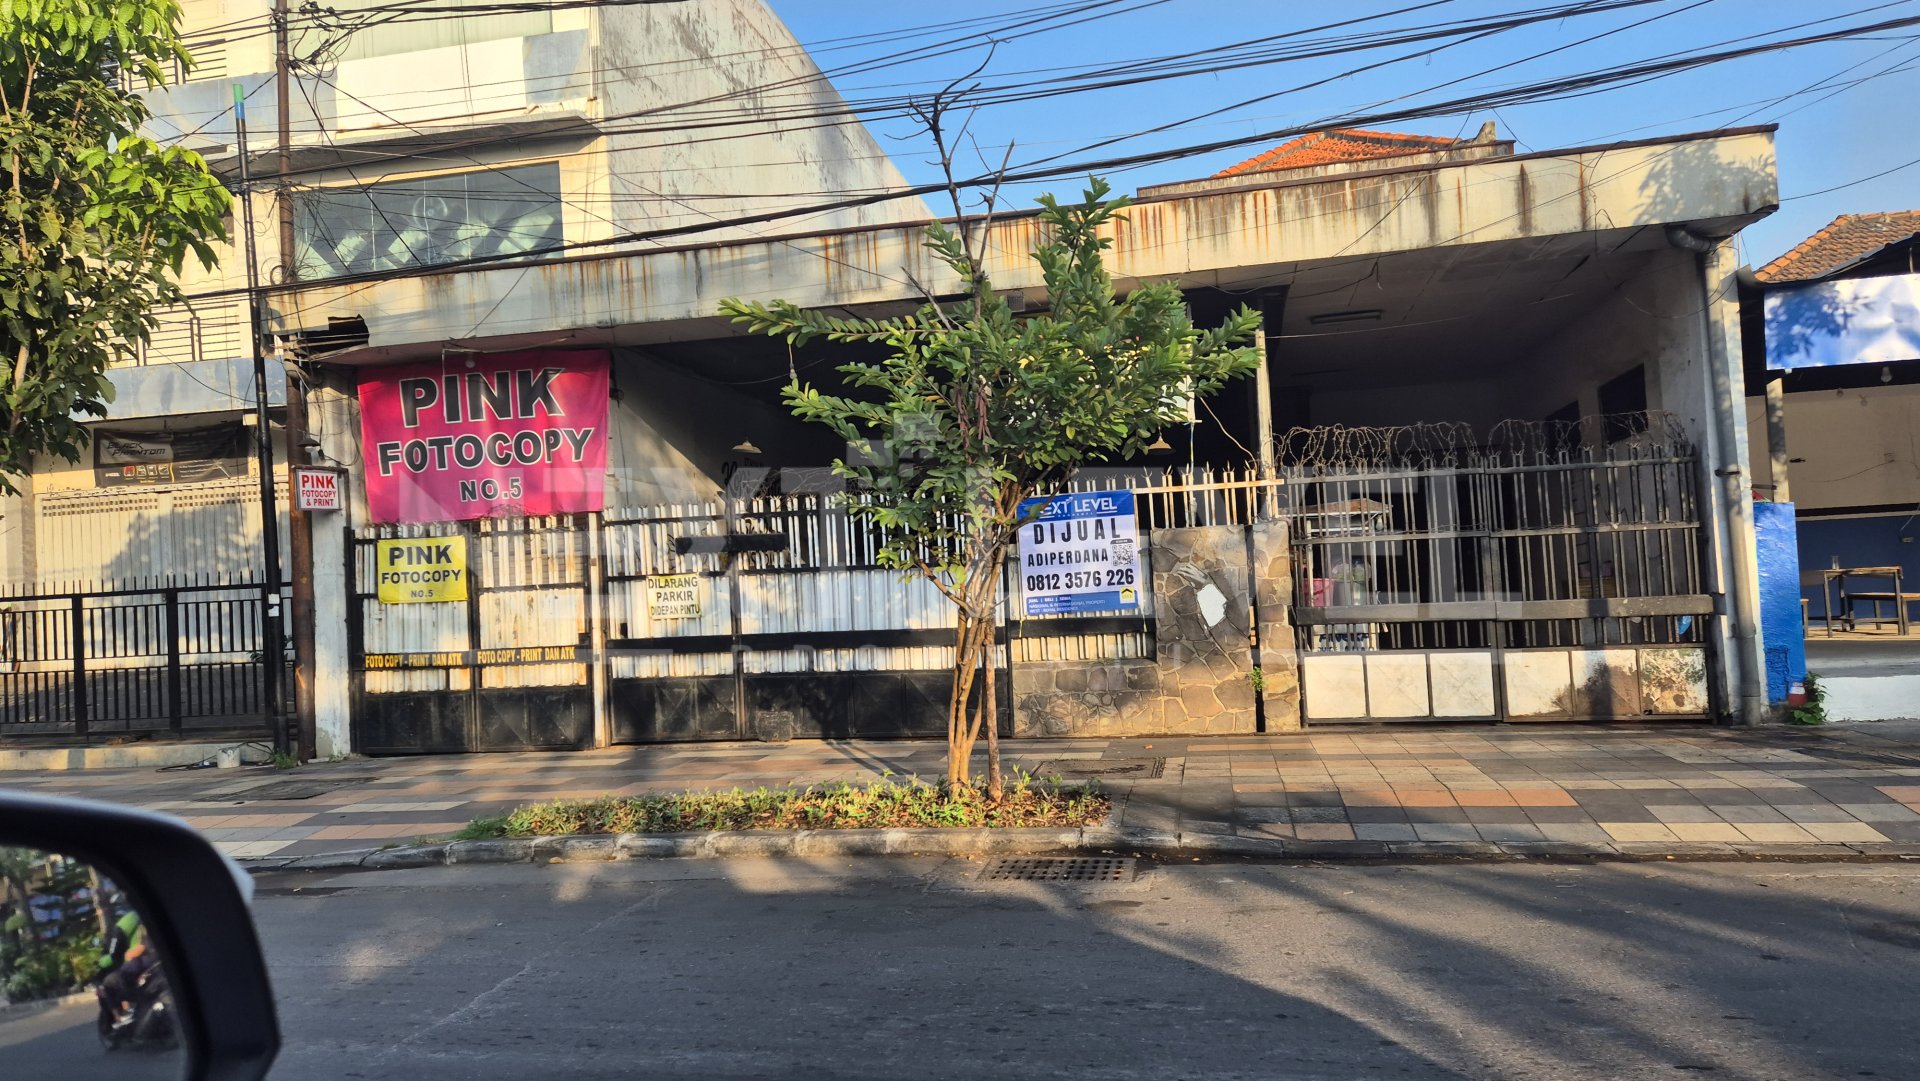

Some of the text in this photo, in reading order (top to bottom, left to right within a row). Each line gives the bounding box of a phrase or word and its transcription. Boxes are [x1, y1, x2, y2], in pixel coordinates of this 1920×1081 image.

[399, 367, 566, 429] PINK
[107, 441, 144, 450] BLACK
[112, 448, 166, 457] PHANTOM
[377, 427, 595, 477] FOTOCOPY
[301, 474, 335, 489] PINK
[459, 476, 523, 502] NO.5
[302, 490, 336, 498] FOTOCOPY
[314, 498, 334, 506] PRINT
[1040, 497, 1118, 516] EXT LEVEL
[1033, 518, 1121, 545] DIJUAL
[389, 544, 452, 566] PINK
[1028, 548, 1109, 568] ADIPERDANA
[382, 569, 462, 584] FOTOCOPY
[648, 576, 698, 588] DILARANG
[1027, 568, 1134, 592] 0812 3576 226
[410, 590, 434, 598] NO.5
[656, 590, 694, 602] PARKIR
[650, 604, 700, 616] DIDEPAN PINTU
[365, 654, 384, 668] FOTO
[384, 654, 404, 668] COPY
[409, 653, 430, 667] PRINT
[432, 652, 447, 666] DAN
[448, 652, 463, 666] ATK
[477, 650, 496, 664] FOTO
[496, 649, 515, 664] COPY
[520, 648, 542, 662] PRINT
[544, 647, 559, 661] DAN
[560, 646, 576, 660] ATK
